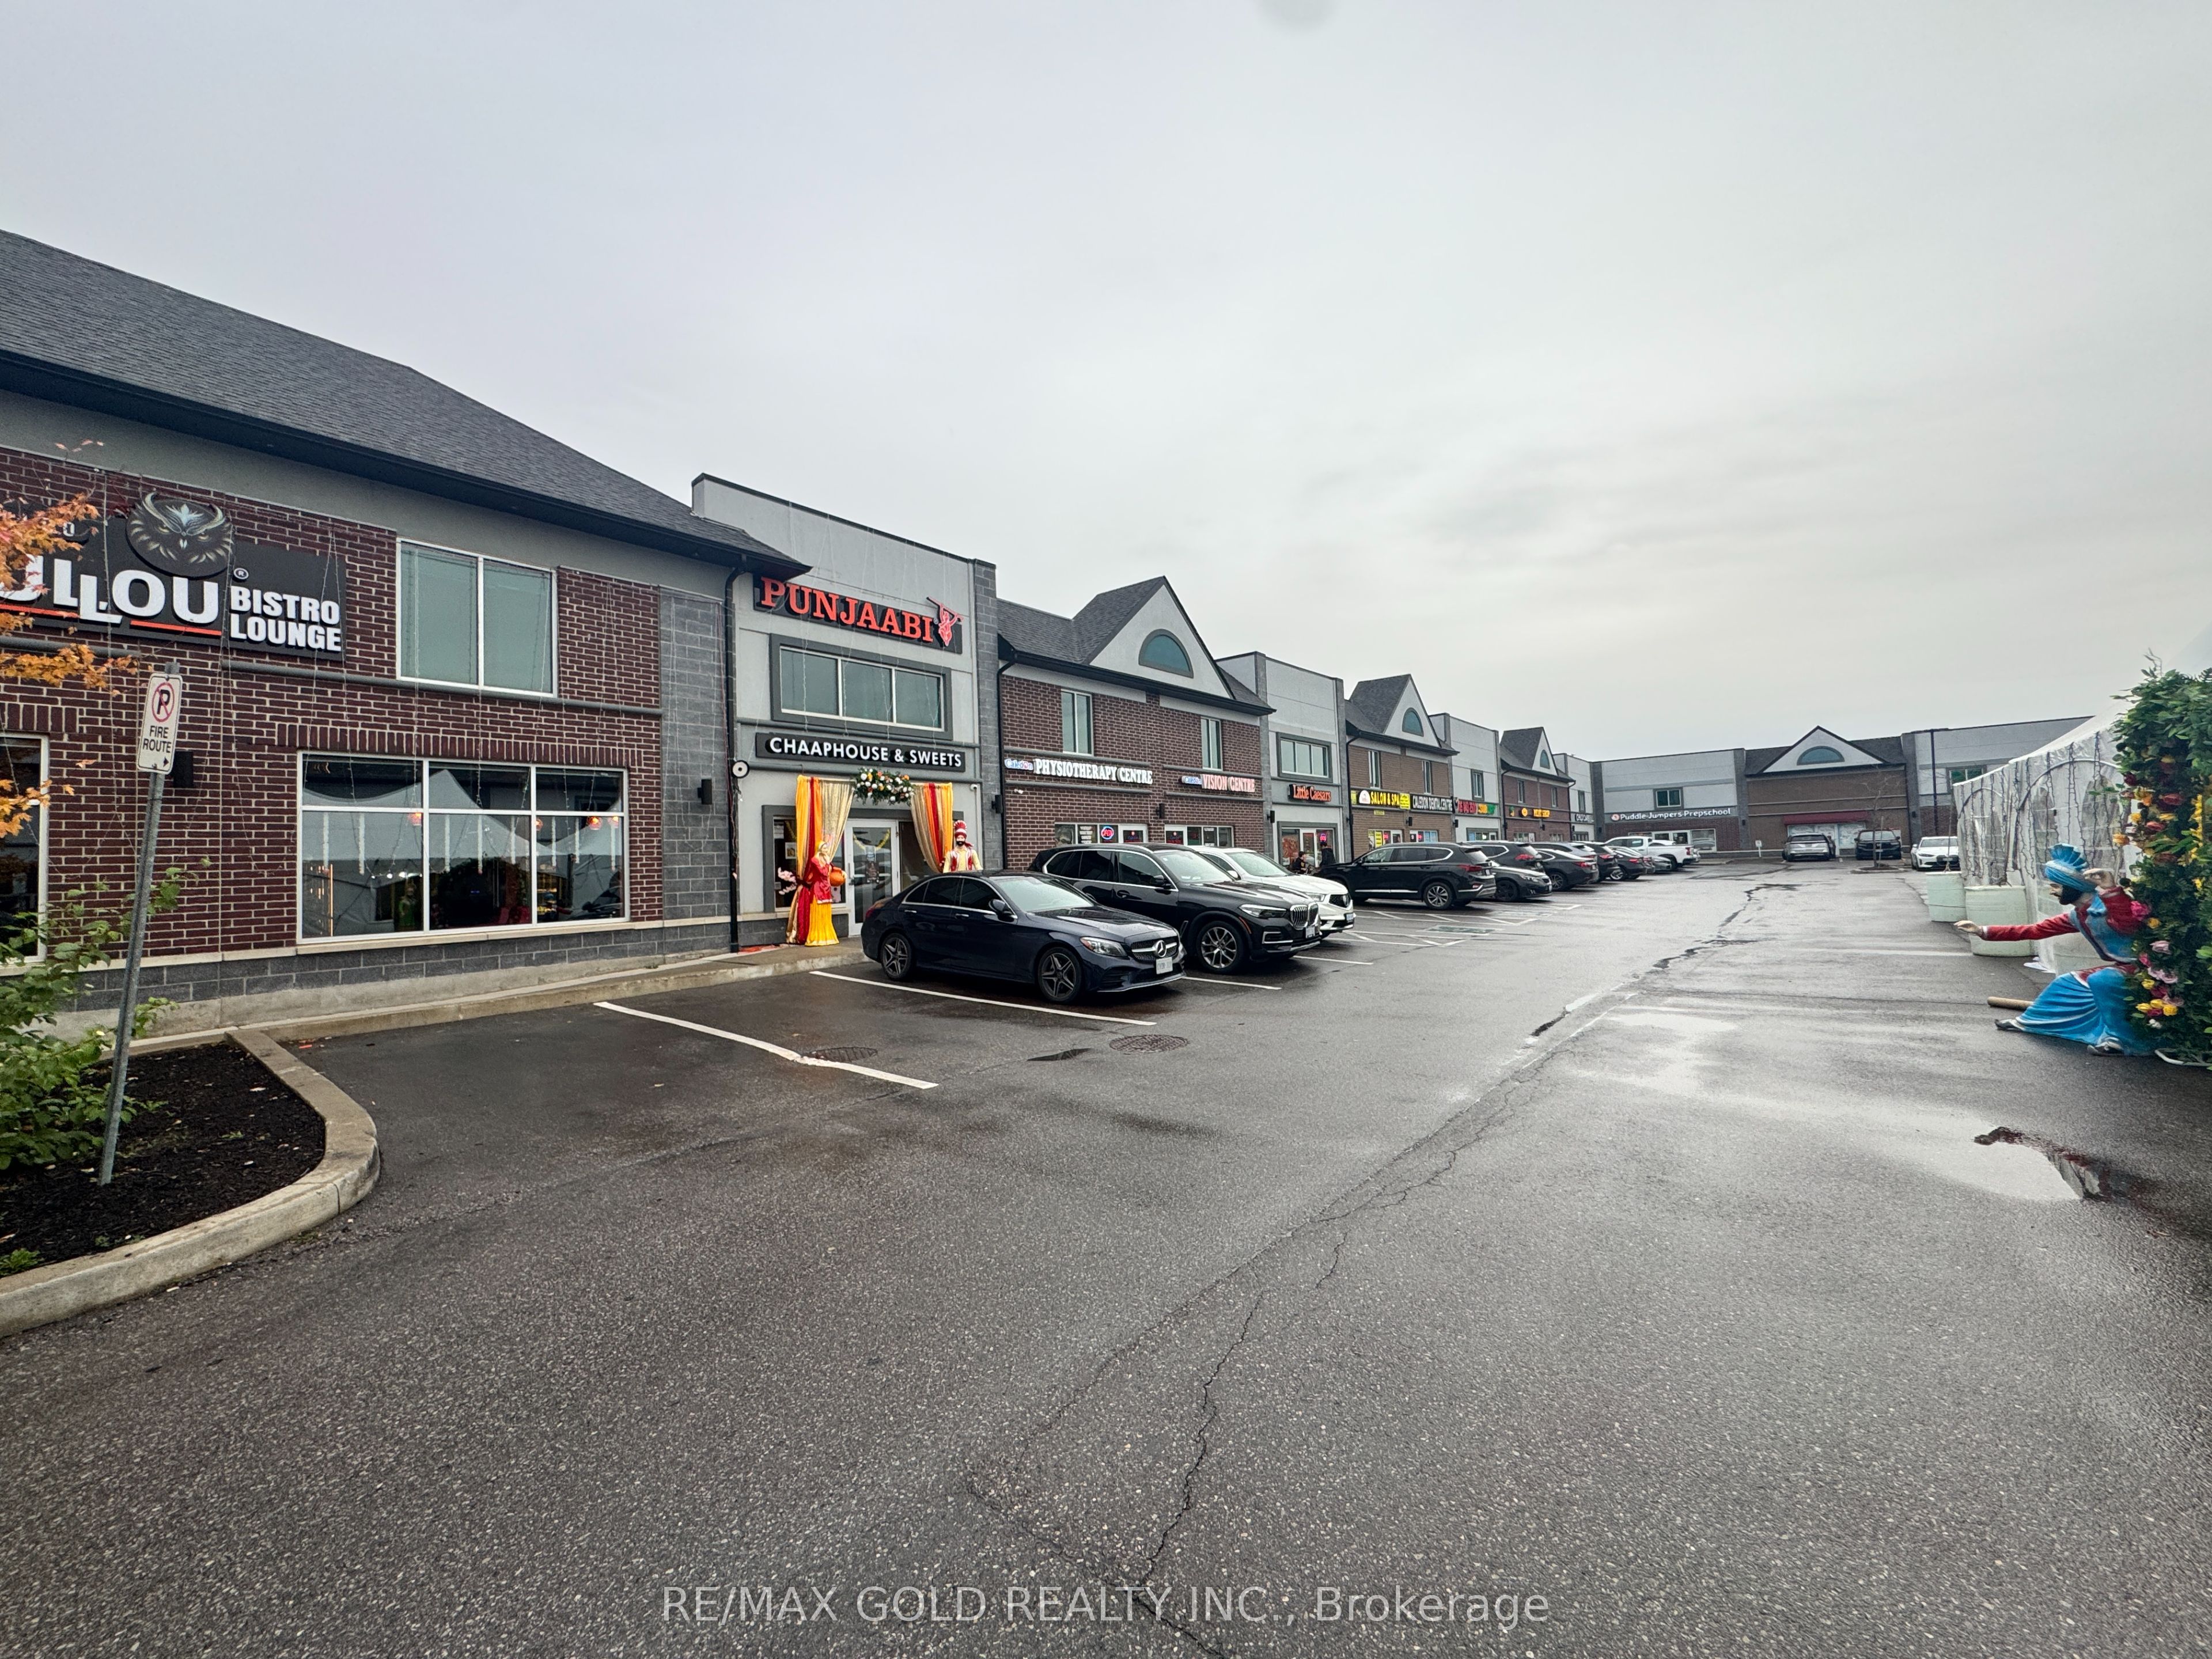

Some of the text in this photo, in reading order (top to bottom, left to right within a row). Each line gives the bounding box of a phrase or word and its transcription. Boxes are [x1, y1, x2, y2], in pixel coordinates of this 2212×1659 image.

[230, 585, 340, 625] BISTRO
[761, 577, 934, 643] PUNJAABI
[230, 613, 341, 652] LOUNGE
[149, 725, 169, 738] FIRE
[143, 738, 172, 753] ROUTE
[770, 737, 961, 767] CHAAPHOUSE & SWEETS
[1035, 759, 1118, 781] PHYSIOTHERAPY
[1118, 767, 1153, 785] CENTRE
[1201, 774, 1228, 791] VISION
[1229, 777, 1255, 793] CENTRE
[1293, 784, 1331, 802] Little Caesars
[1370, 791, 1387, 805] SALON
[1392, 794, 1400, 805] SPA
[1648, 811, 1682, 820] Jumpers
[1684, 808, 1730, 818] Prepschool
